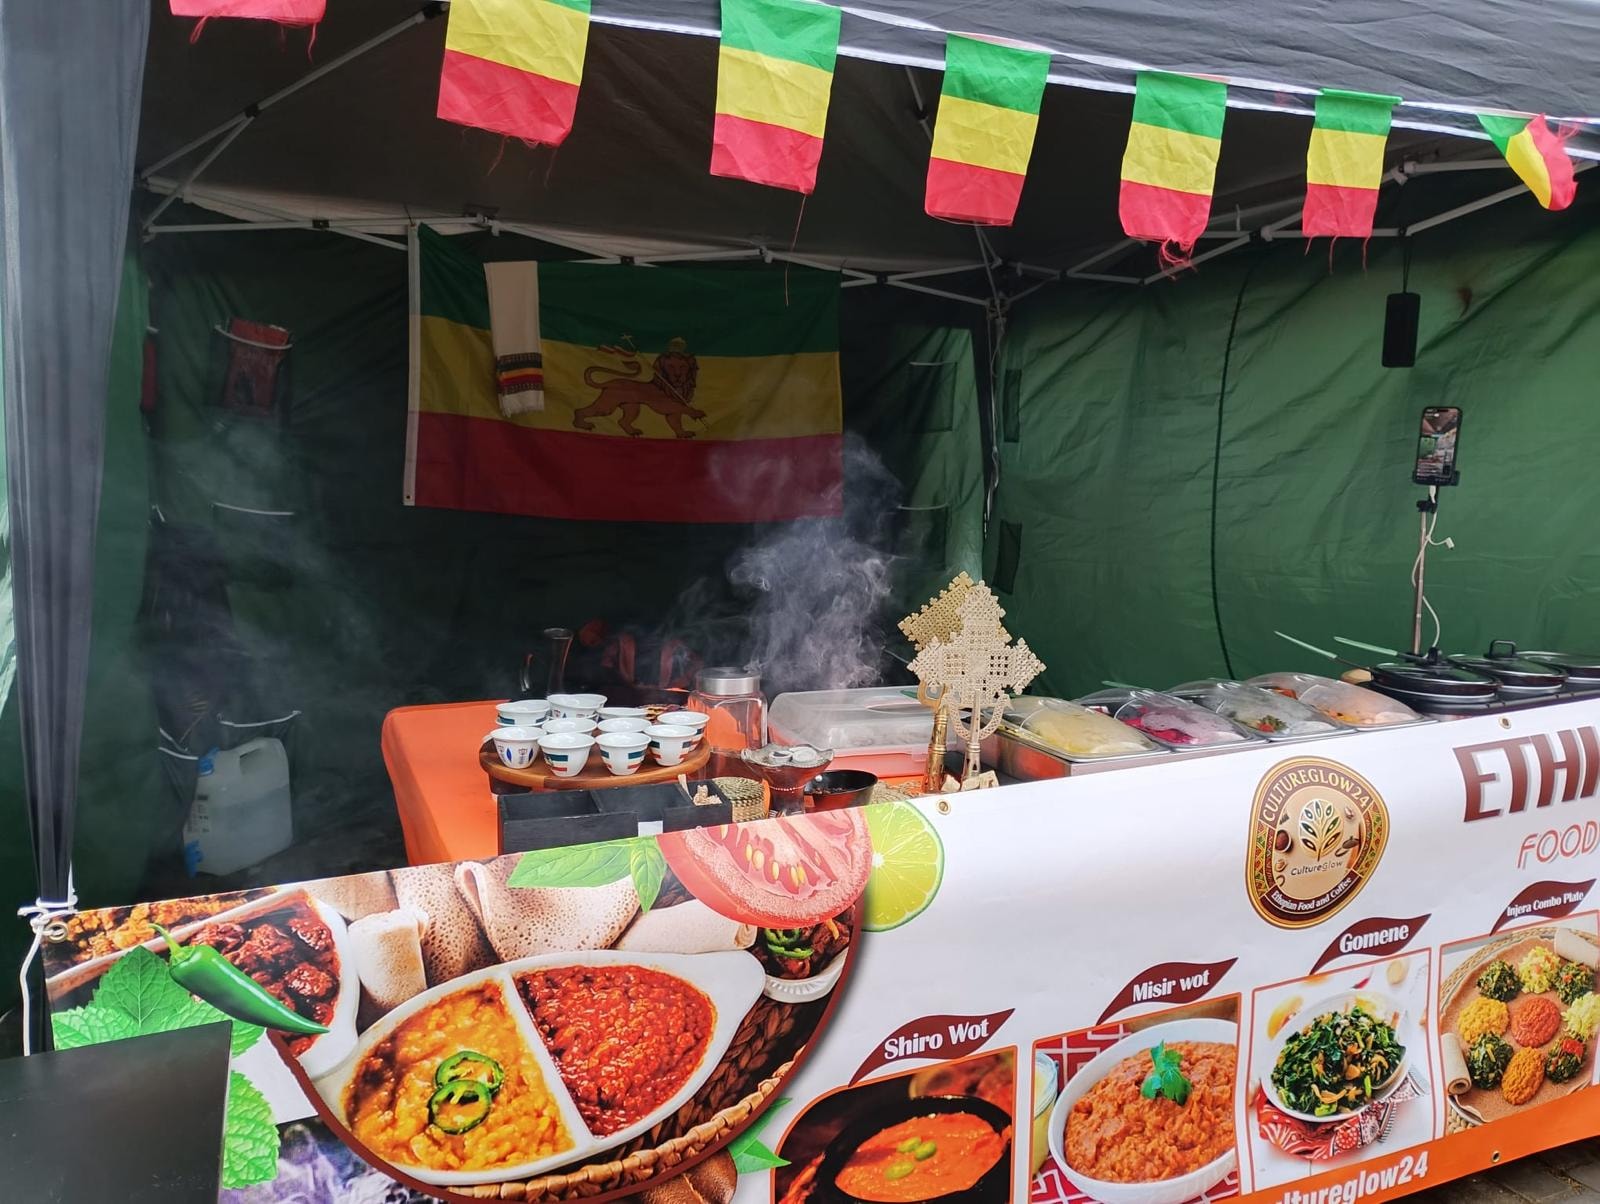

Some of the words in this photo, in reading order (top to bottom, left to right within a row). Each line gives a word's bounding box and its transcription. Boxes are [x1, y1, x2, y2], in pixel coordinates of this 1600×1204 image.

[1452, 726, 1600, 822] ETHI
[1262, 768, 1370, 822] CULTUREGLOW24
[1517, 820, 1599, 869] FOOD
[1290, 861, 1343, 876] CultureGlow
[1297, 900, 1315, 911] Food
[1315, 894, 1330, 907] and
[1330, 877, 1352, 898] Coffee
[1506, 904, 1532, 917] Injera
[1532, 896, 1562, 911] Combo
[1563, 891, 1585, 905] Plate
[1339, 924, 1409, 953] Gomene
[1132, 977, 1176, 1002] Misir
[1179, 969, 1210, 991] wot
[884, 1032, 943, 1060] Shiro
[948, 1018, 990, 1045] Wot
[1275, 1151, 1429, 1204] tureglow24
